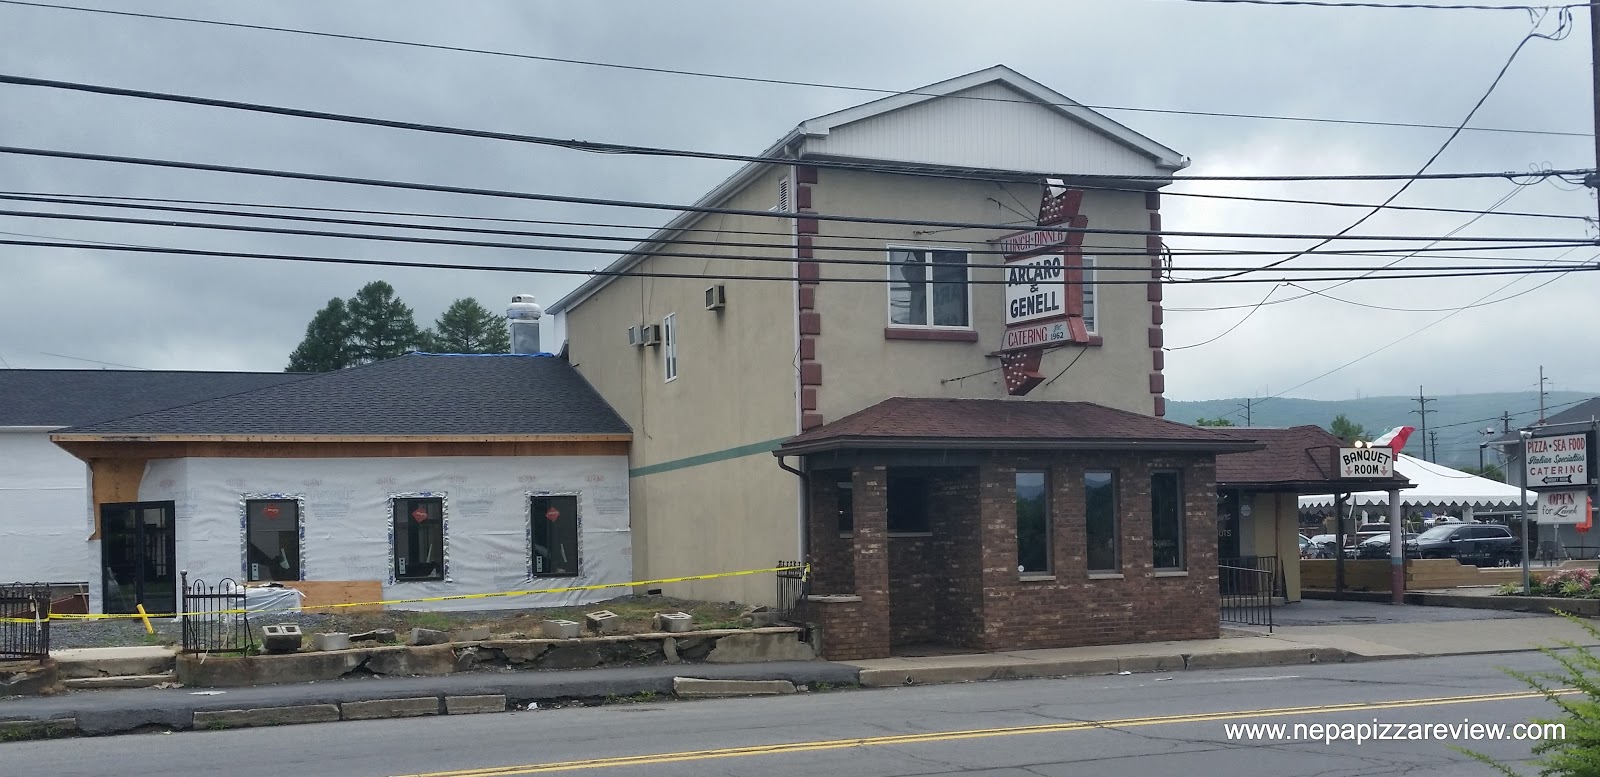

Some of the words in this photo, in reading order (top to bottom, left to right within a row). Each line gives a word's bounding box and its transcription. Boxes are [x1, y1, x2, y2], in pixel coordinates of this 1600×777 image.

[1005, 234, 1031, 252] LUNCH
[1034, 229, 1063, 247] DINNER
[1008, 257, 1061, 287] ARCARO
[1029, 282, 1039, 292] &
[1010, 291, 1060, 318] GENELL
[1008, 326, 1048, 347] CATERING
[1050, 331, 1064, 341] 1962
[1527, 440, 1548, 454] PIZZA
[1553, 438, 1566, 451] SEA
[1569, 437, 1585, 450] FOOD
[1342, 450, 1391, 466] BANQUET
[1528, 454, 1552, 465] Italian
[1554, 453, 1585, 465] Specialties
[1354, 464, 1379, 475] ROOM
[1530, 464, 1584, 476] CATERING
[1547, 493, 1575, 505] OPEN
[1541, 504, 1553, 515] for
[1218, 529, 1232, 537] UTS
